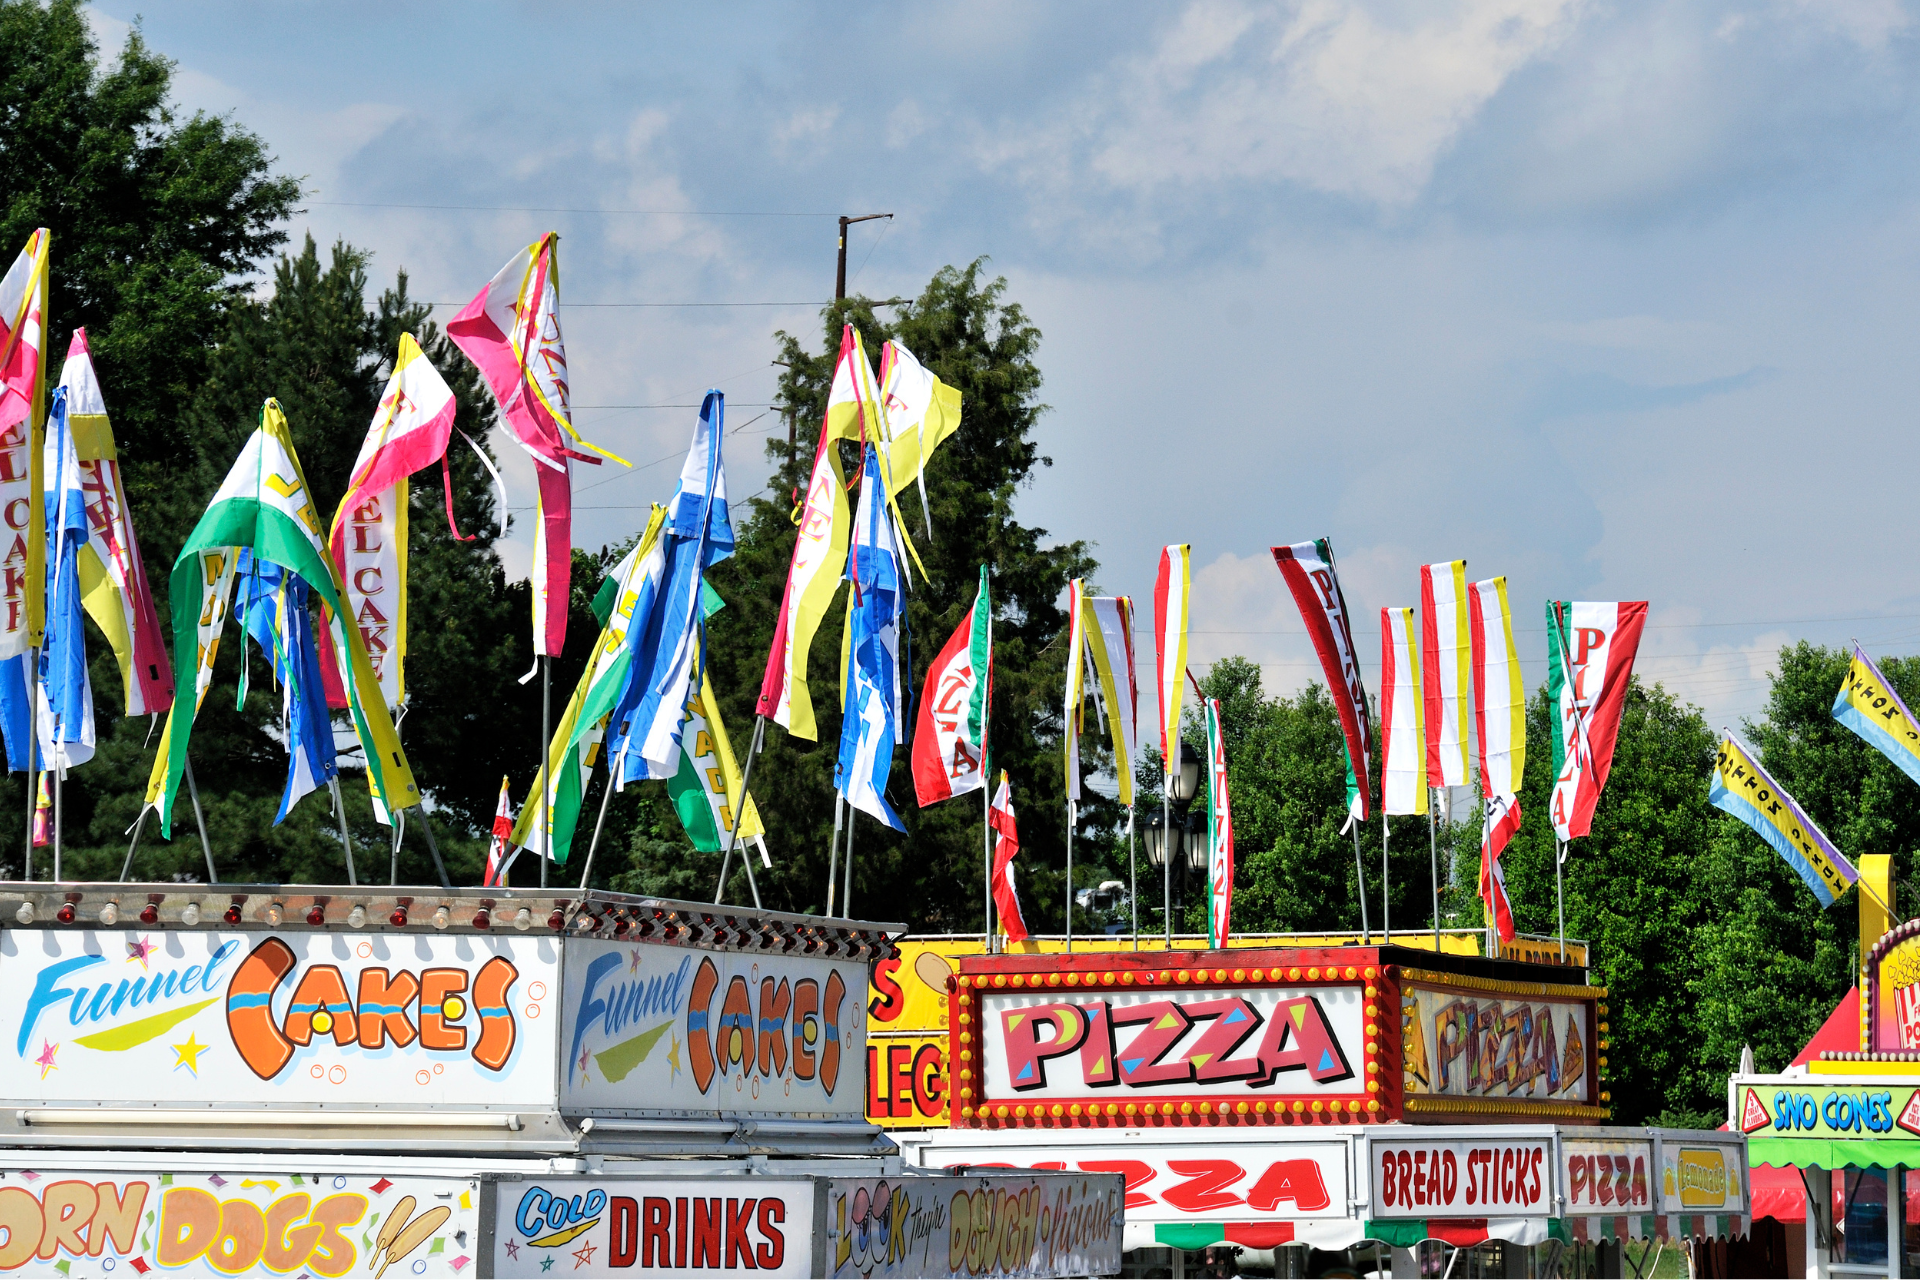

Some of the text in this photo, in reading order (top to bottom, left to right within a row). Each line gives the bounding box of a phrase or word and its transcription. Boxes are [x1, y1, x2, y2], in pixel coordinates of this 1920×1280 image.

[16, 936, 519, 1081] Funnel CAKES
[568, 951, 846, 1096] Funnel CAKES
[1000, 995, 1355, 1092] PIZZA
[1434, 999, 1563, 1097] PIZZA
[866, 1043, 950, 1118] LEG
[1773, 1089, 1893, 1133] SNO CONES
[1382, 1146, 1543, 1210] BREAD STICKS
[1568, 1154, 1648, 1207] PIZZA
[1678, 1157, 1726, 1195] Lemonade
[0, 1180, 370, 1279] ORN DOGS
[515, 1185, 786, 1270] COLD DRINKS
[949, 1184, 1041, 1278] DOUGH
